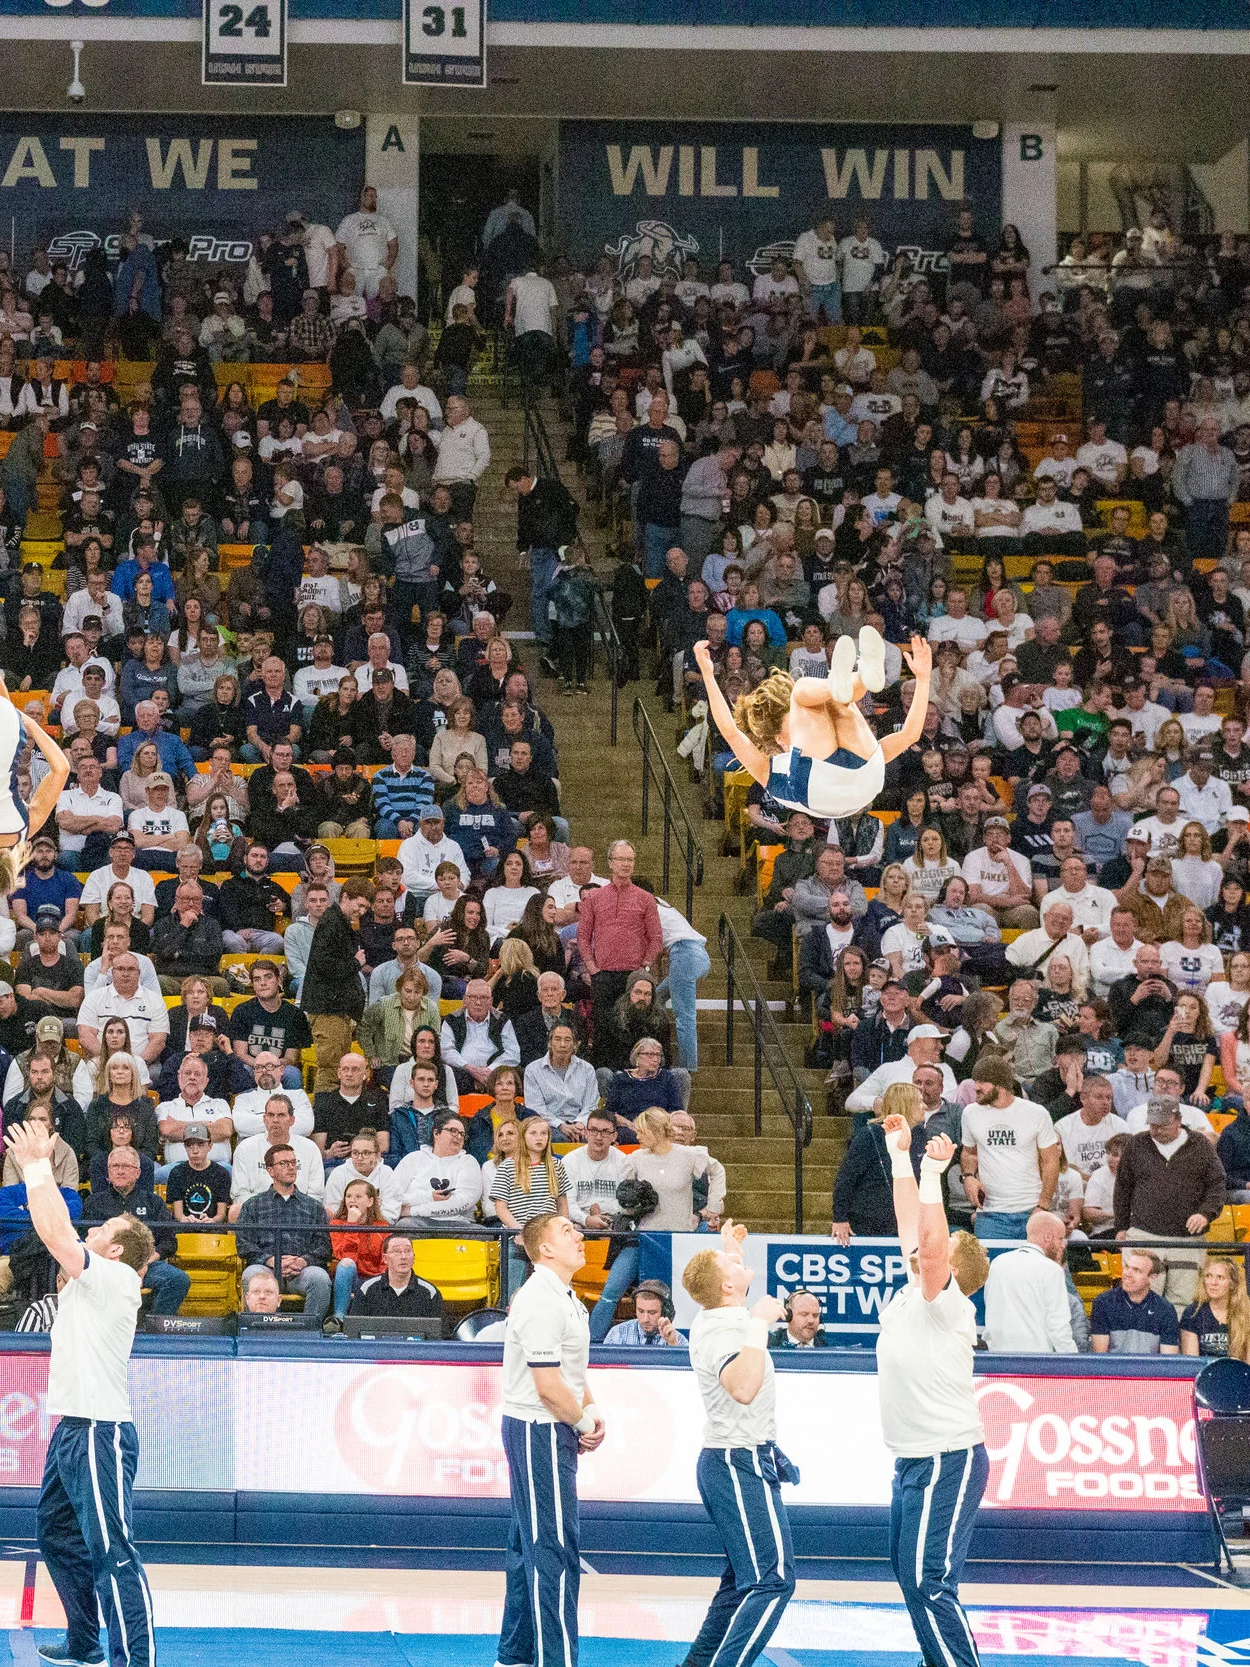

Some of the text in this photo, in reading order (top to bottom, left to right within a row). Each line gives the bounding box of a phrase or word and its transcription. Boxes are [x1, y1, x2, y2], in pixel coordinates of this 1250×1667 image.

[218, 4, 272, 38] 24
[421, 5, 467, 38] 31
[380, 125, 406, 152] A
[1019, 134, 1044, 162] B
[146, 137, 260, 191] WE
[606, 144, 966, 201] WILL WIN
[185, 235, 254, 262] Pro
[142, 824, 173, 834] STATE
[248, 1033, 286, 1049] STATE
[986, 1137, 1017, 1146] STATE
[988, 1129, 1015, 1138] UTAH
[1080, 1150, 1106, 1162] HOOP
[775, 1253, 856, 1283] CBS
